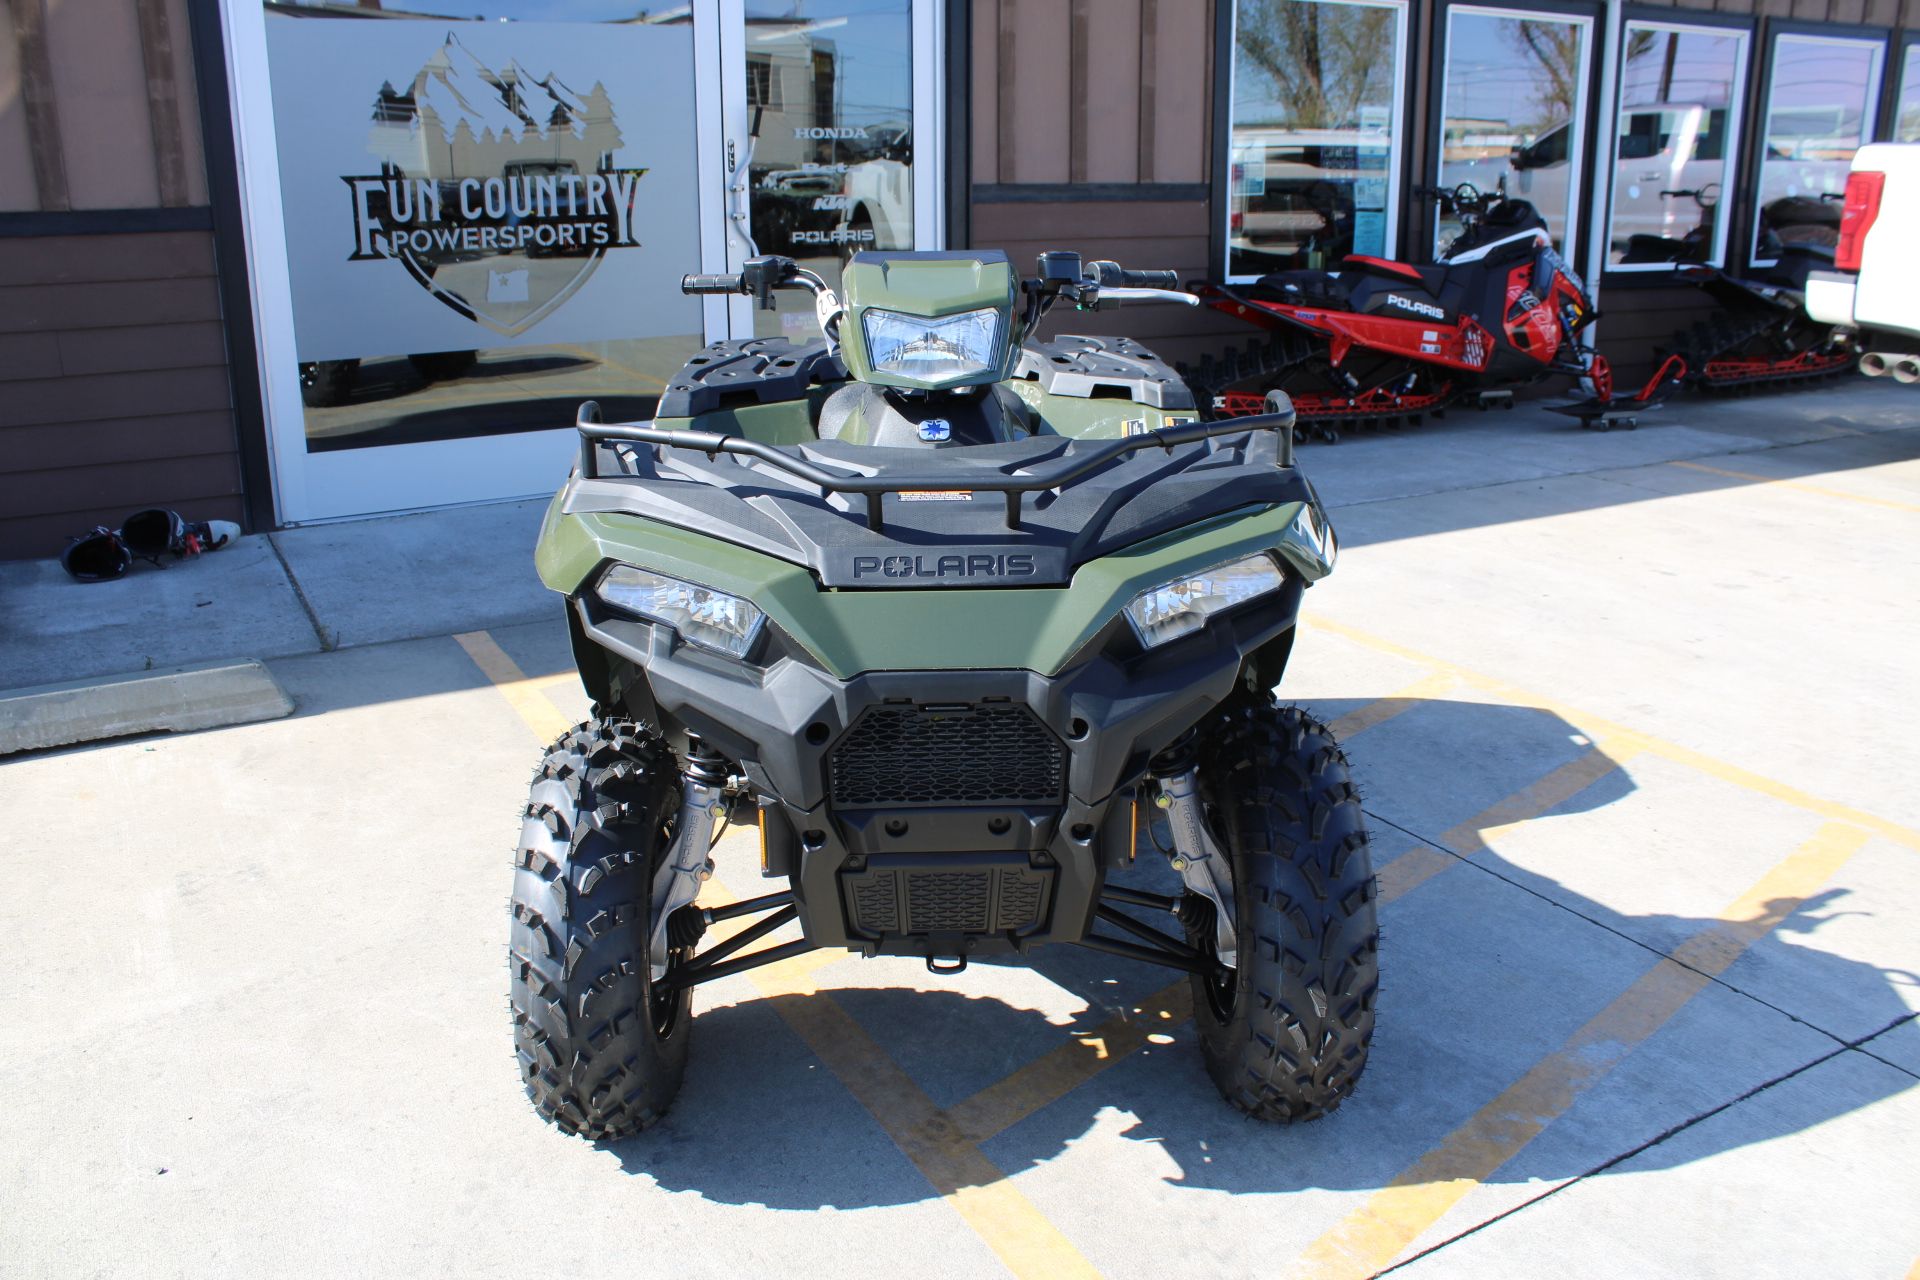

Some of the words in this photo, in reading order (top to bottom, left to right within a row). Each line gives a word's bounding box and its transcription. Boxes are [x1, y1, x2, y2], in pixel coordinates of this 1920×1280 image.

[794, 127, 869, 139] HONDA
[353, 178, 441, 255] FUN
[458, 172, 640, 244] COUNTRY
[392, 221, 610, 252] POWERSPORTS
[792, 229, 874, 243] POLARIS
[1387, 293, 1445, 319] POLARIS
[853, 554, 1037, 579] POLARIS
